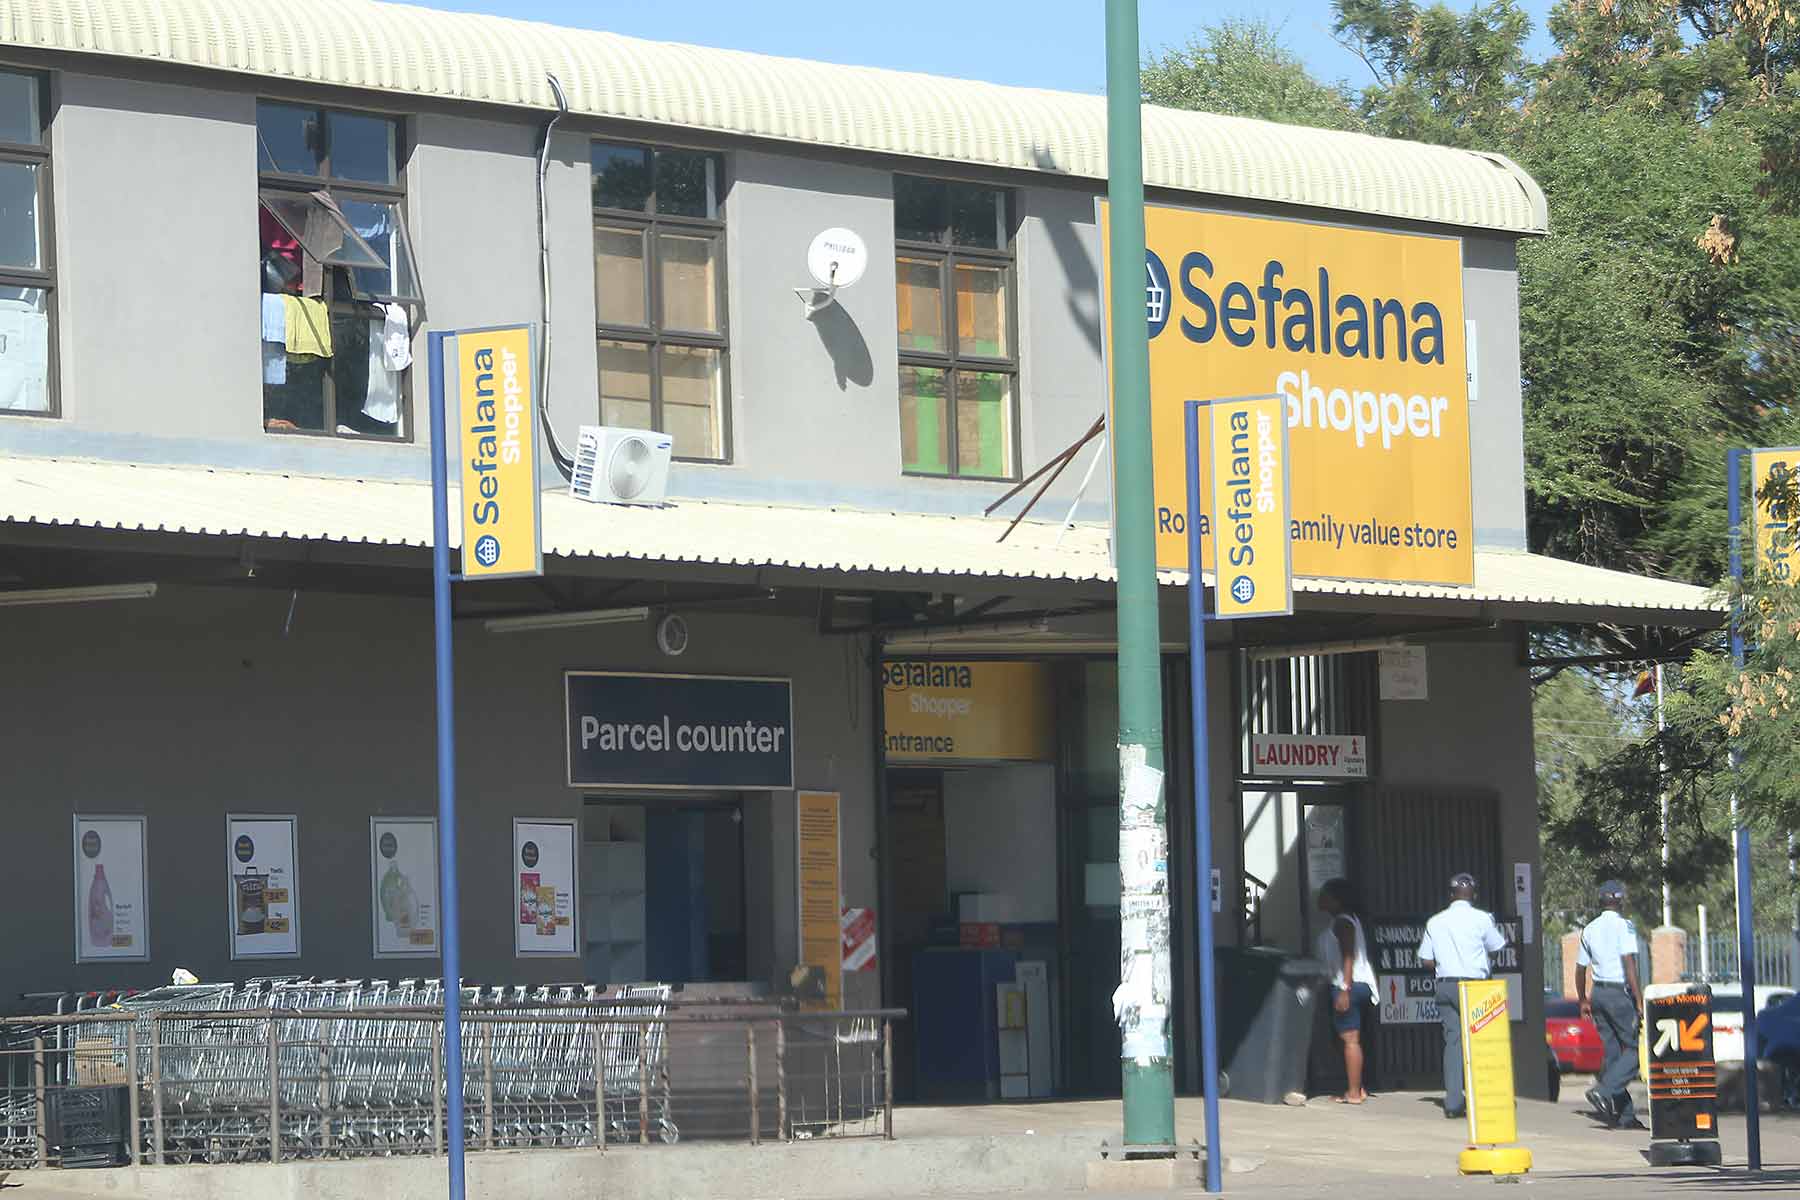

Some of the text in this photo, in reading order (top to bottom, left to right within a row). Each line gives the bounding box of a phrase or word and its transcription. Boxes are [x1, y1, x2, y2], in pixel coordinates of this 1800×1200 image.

[1179, 250, 1446, 366] Sefalana
[471, 347, 500, 526] Sefalana
[501, 346, 524, 465] Shopper
[1276, 369, 1449, 449] Shopper
[1226, 410, 1254, 567] Sefalana
[1256, 409, 1277, 513] Shopper
[1158, 507, 1458, 550] Roa amily value store
[580, 715, 785, 754] Parcel counter
[911, 692, 972, 720] Shopper
[1255, 743, 1340, 766] LAUNDRY
[1381, 948, 1423, 969] & BEA
